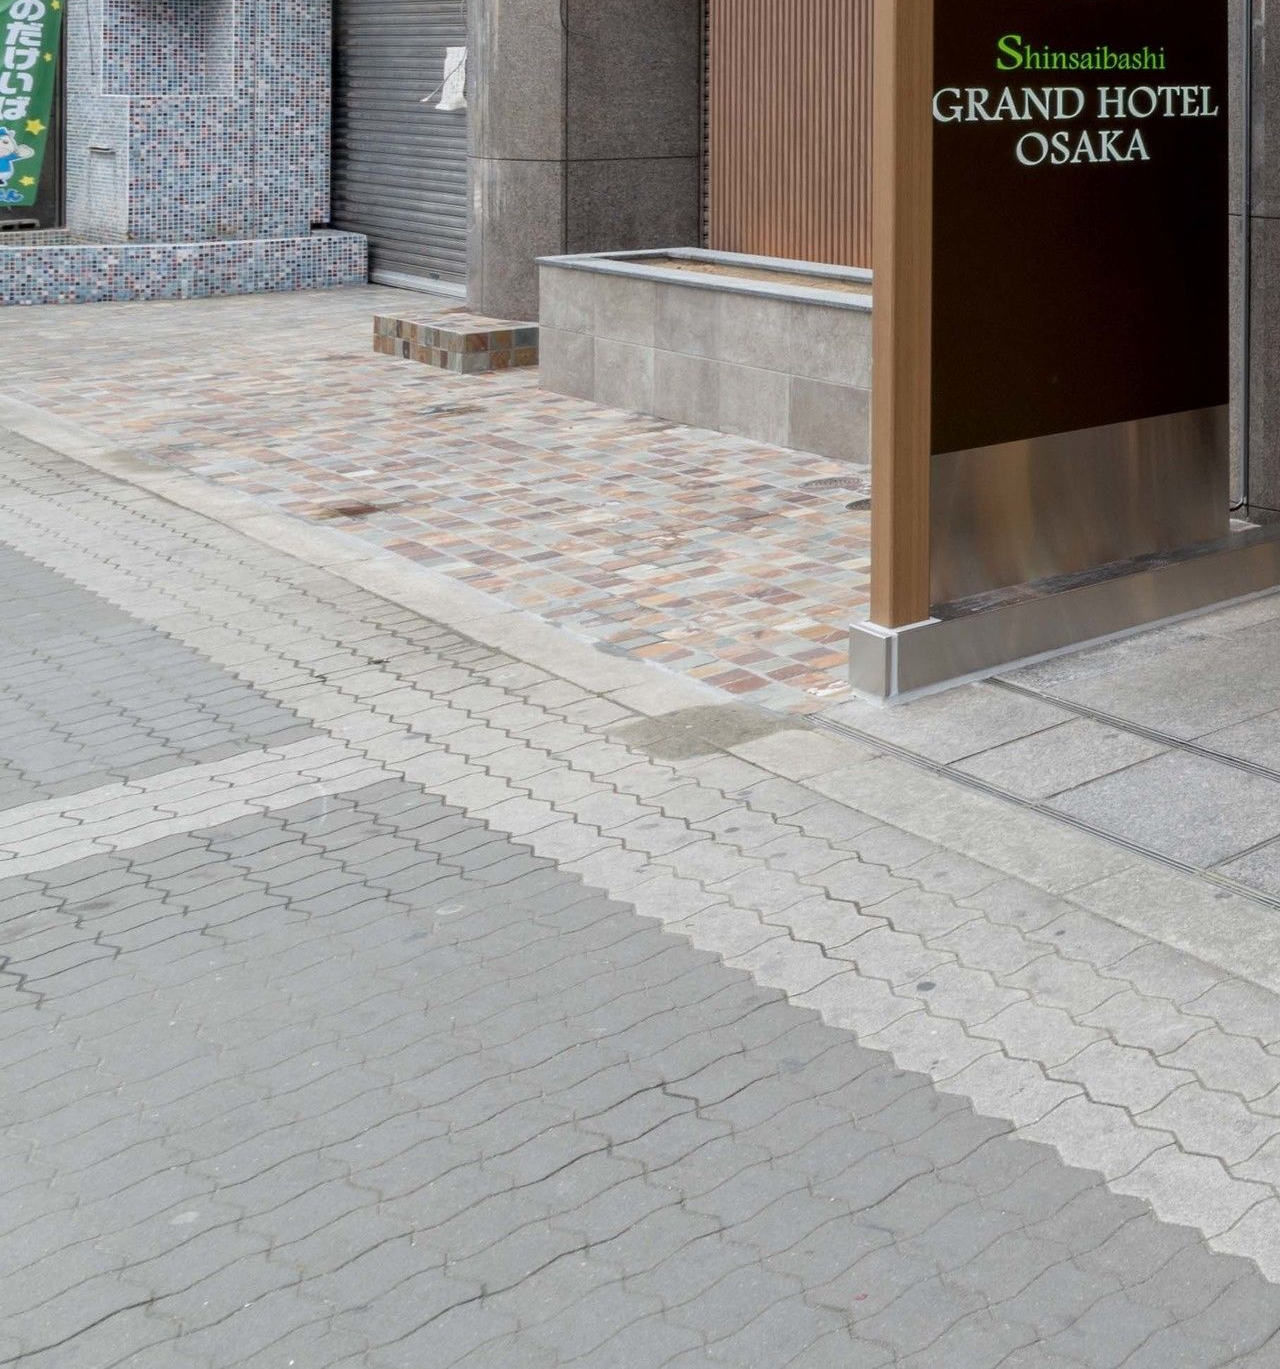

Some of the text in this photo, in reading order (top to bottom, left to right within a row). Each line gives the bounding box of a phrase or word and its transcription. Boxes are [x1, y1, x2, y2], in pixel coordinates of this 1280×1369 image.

[996, 33, 1167, 71] Shinsaibashi
[931, 85, 1219, 123] GRAND HOTEL
[1015, 128, 1151, 166] OSAKA
